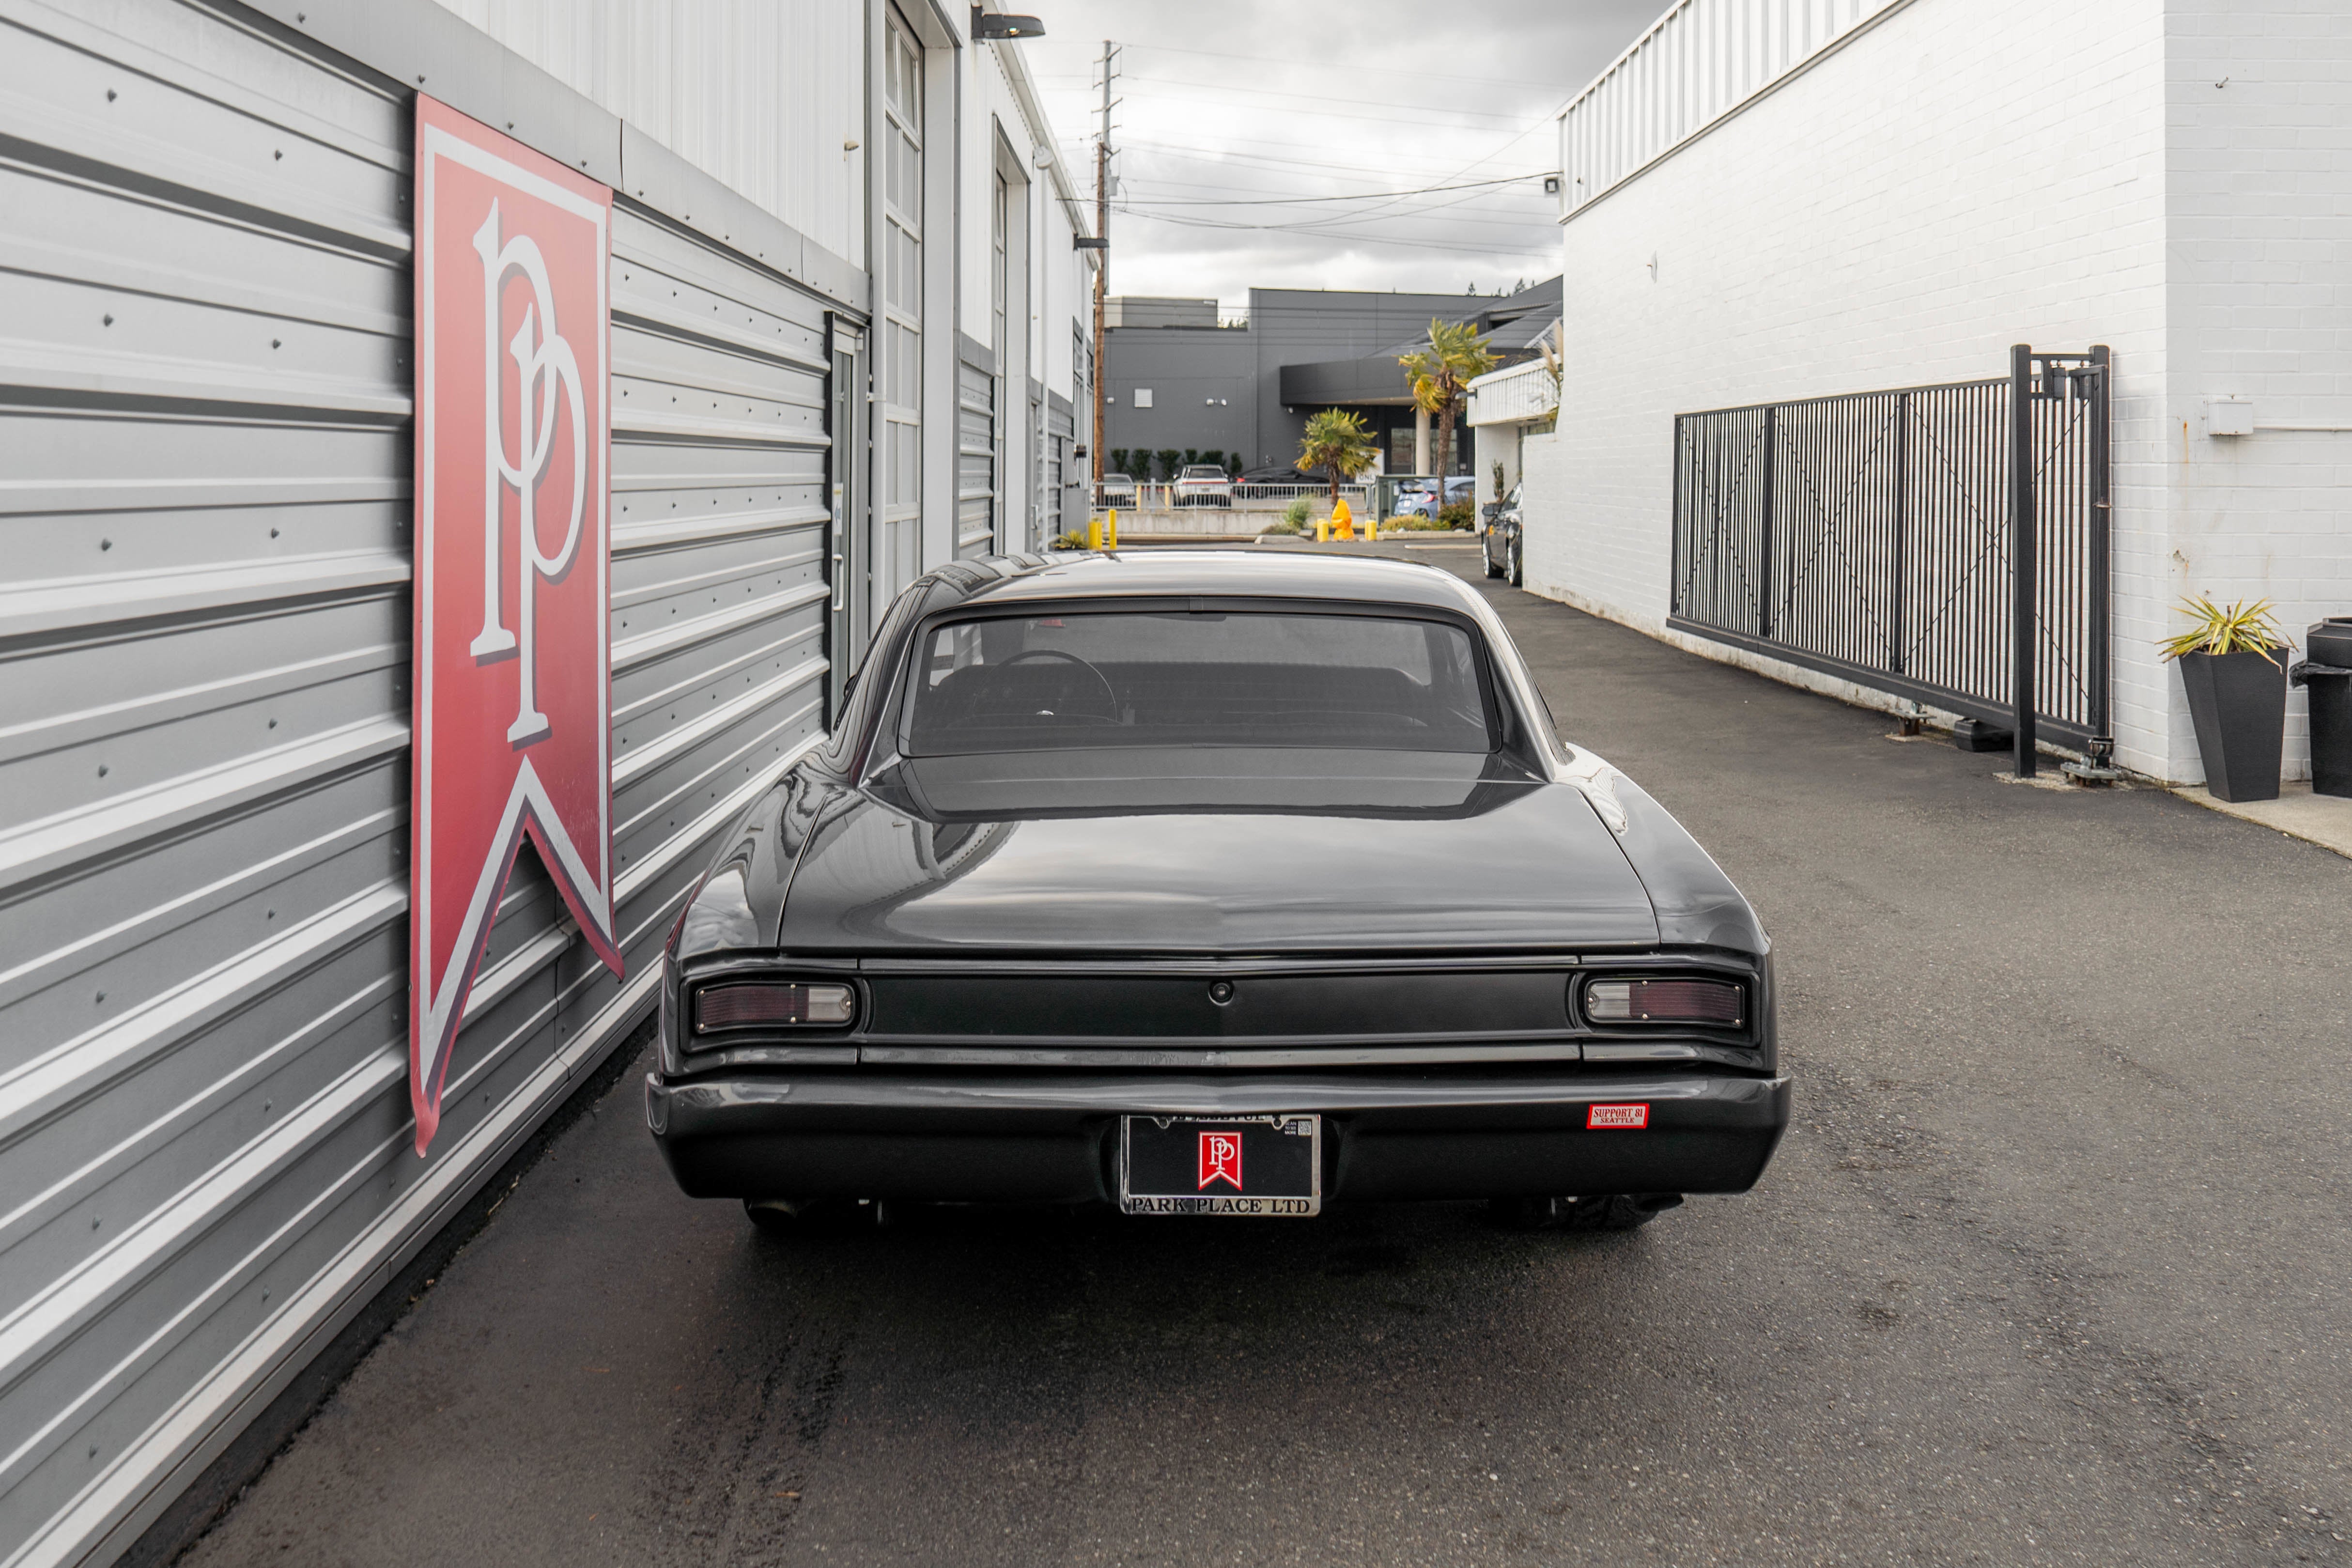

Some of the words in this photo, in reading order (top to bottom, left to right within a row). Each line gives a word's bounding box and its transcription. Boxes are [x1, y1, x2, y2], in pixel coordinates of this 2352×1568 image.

[1594, 1108, 1633, 1118] SUPPORT
[1131, 1198, 1186, 1212] PARK
[1195, 1198, 1262, 1212] PLACE
[1271, 1199, 1310, 1213] LTD
